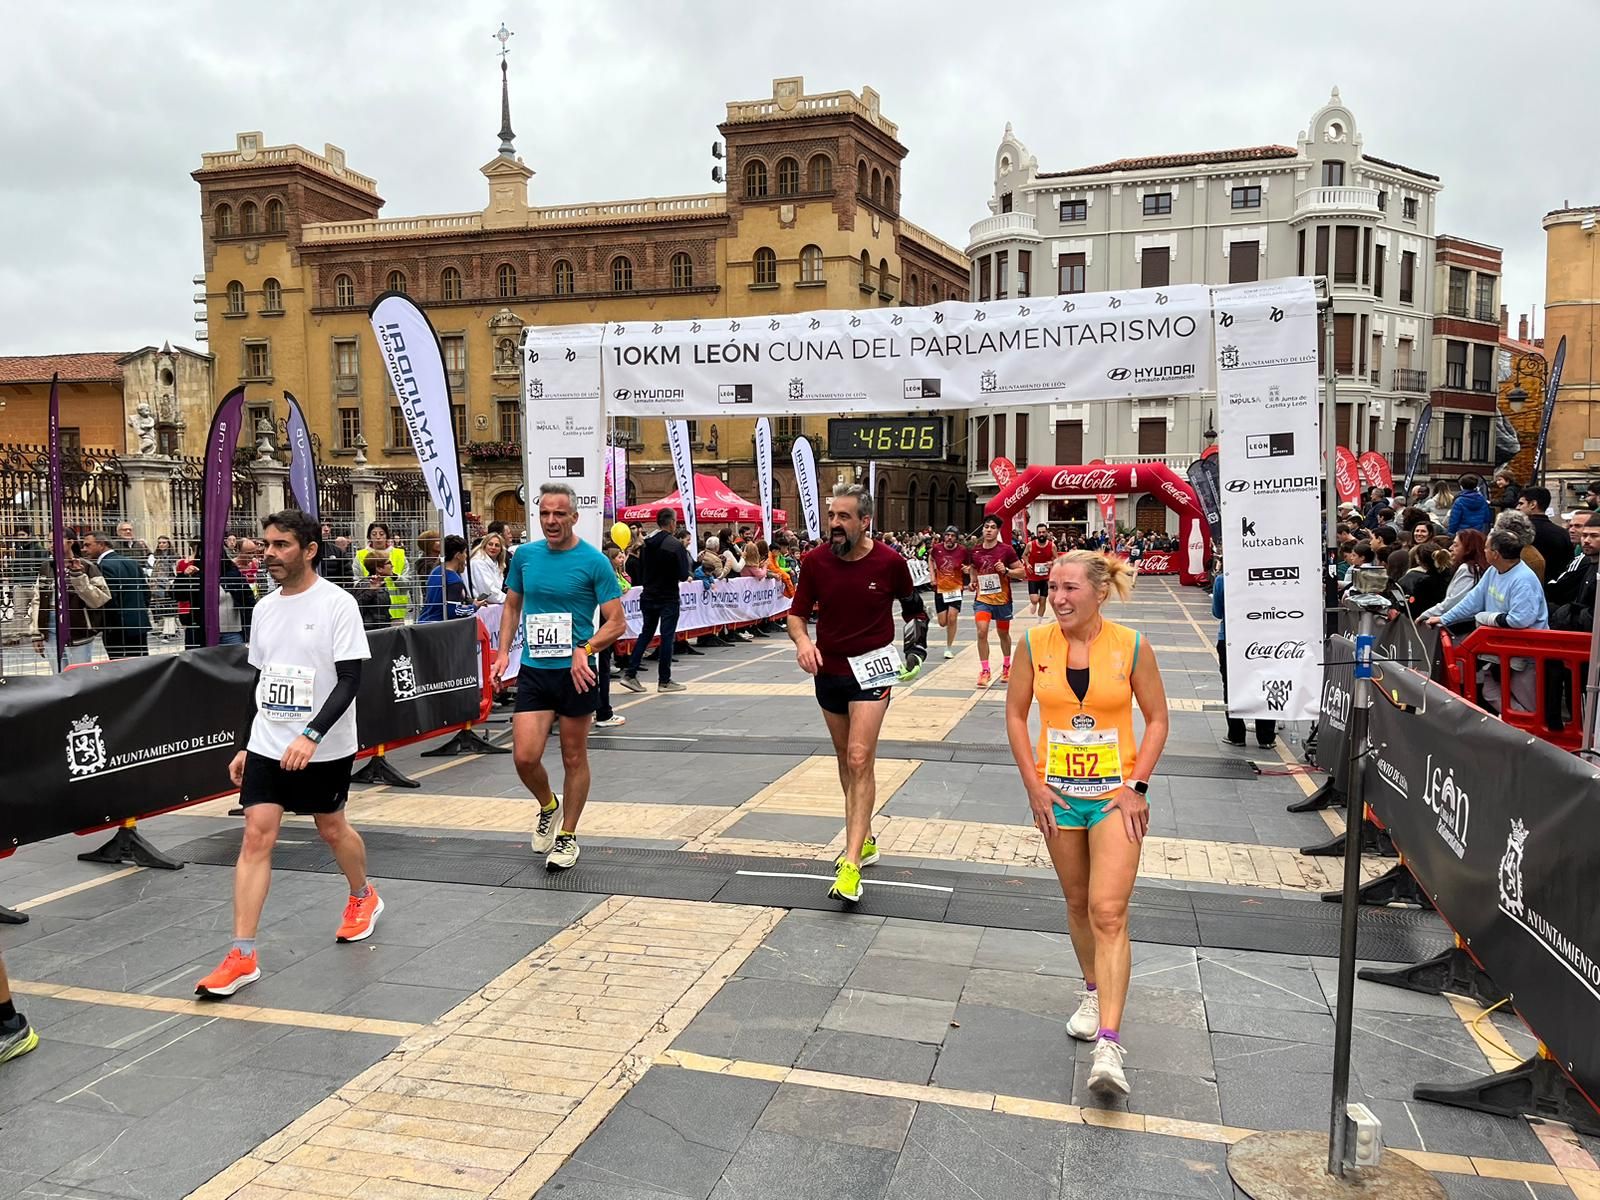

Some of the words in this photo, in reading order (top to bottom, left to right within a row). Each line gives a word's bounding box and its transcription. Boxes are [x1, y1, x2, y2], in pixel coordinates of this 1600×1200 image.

[613, 345, 680, 366] 10KM
[694, 338, 759, 363] LEÓN
[768, 340, 844, 361] CUNA
[853, 338, 901, 359] DEL
[911, 315, 1196, 357] PARLAMENTARISMO
[1135, 364, 1195, 377] HYUNDAI
[634, 389, 684, 399] HYUNDAI
[1051, 469, 1120, 490] Coca-Cola
[1254, 476, 1318, 490] HYUNDAI
[1004, 482, 1030, 509] Coca-Cola
[1160, 481, 1192, 505] Coca-Cola
[700, 507, 728, 519] Coca-Cola
[1242, 536, 1304, 548] kutxabank
[1250, 568, 1298, 579] LEON
[1246, 606, 1304, 620] emico
[537, 628, 558, 644] 641
[1244, 640, 1308, 660] Coca-Cola
[864, 656, 894, 678] 509
[456, 678, 463, 686] DE
[463, 675, 477, 685] LEÓN
[269, 683, 295, 705] 501
[109, 740, 189, 767] AYUNTAMIENTO
[191, 736, 204, 748] DE
[207, 730, 235, 745] LEÓN
[1066, 753, 1100, 777] 152
[1527, 908, 1600, 986] AYUNTAMIENTO
